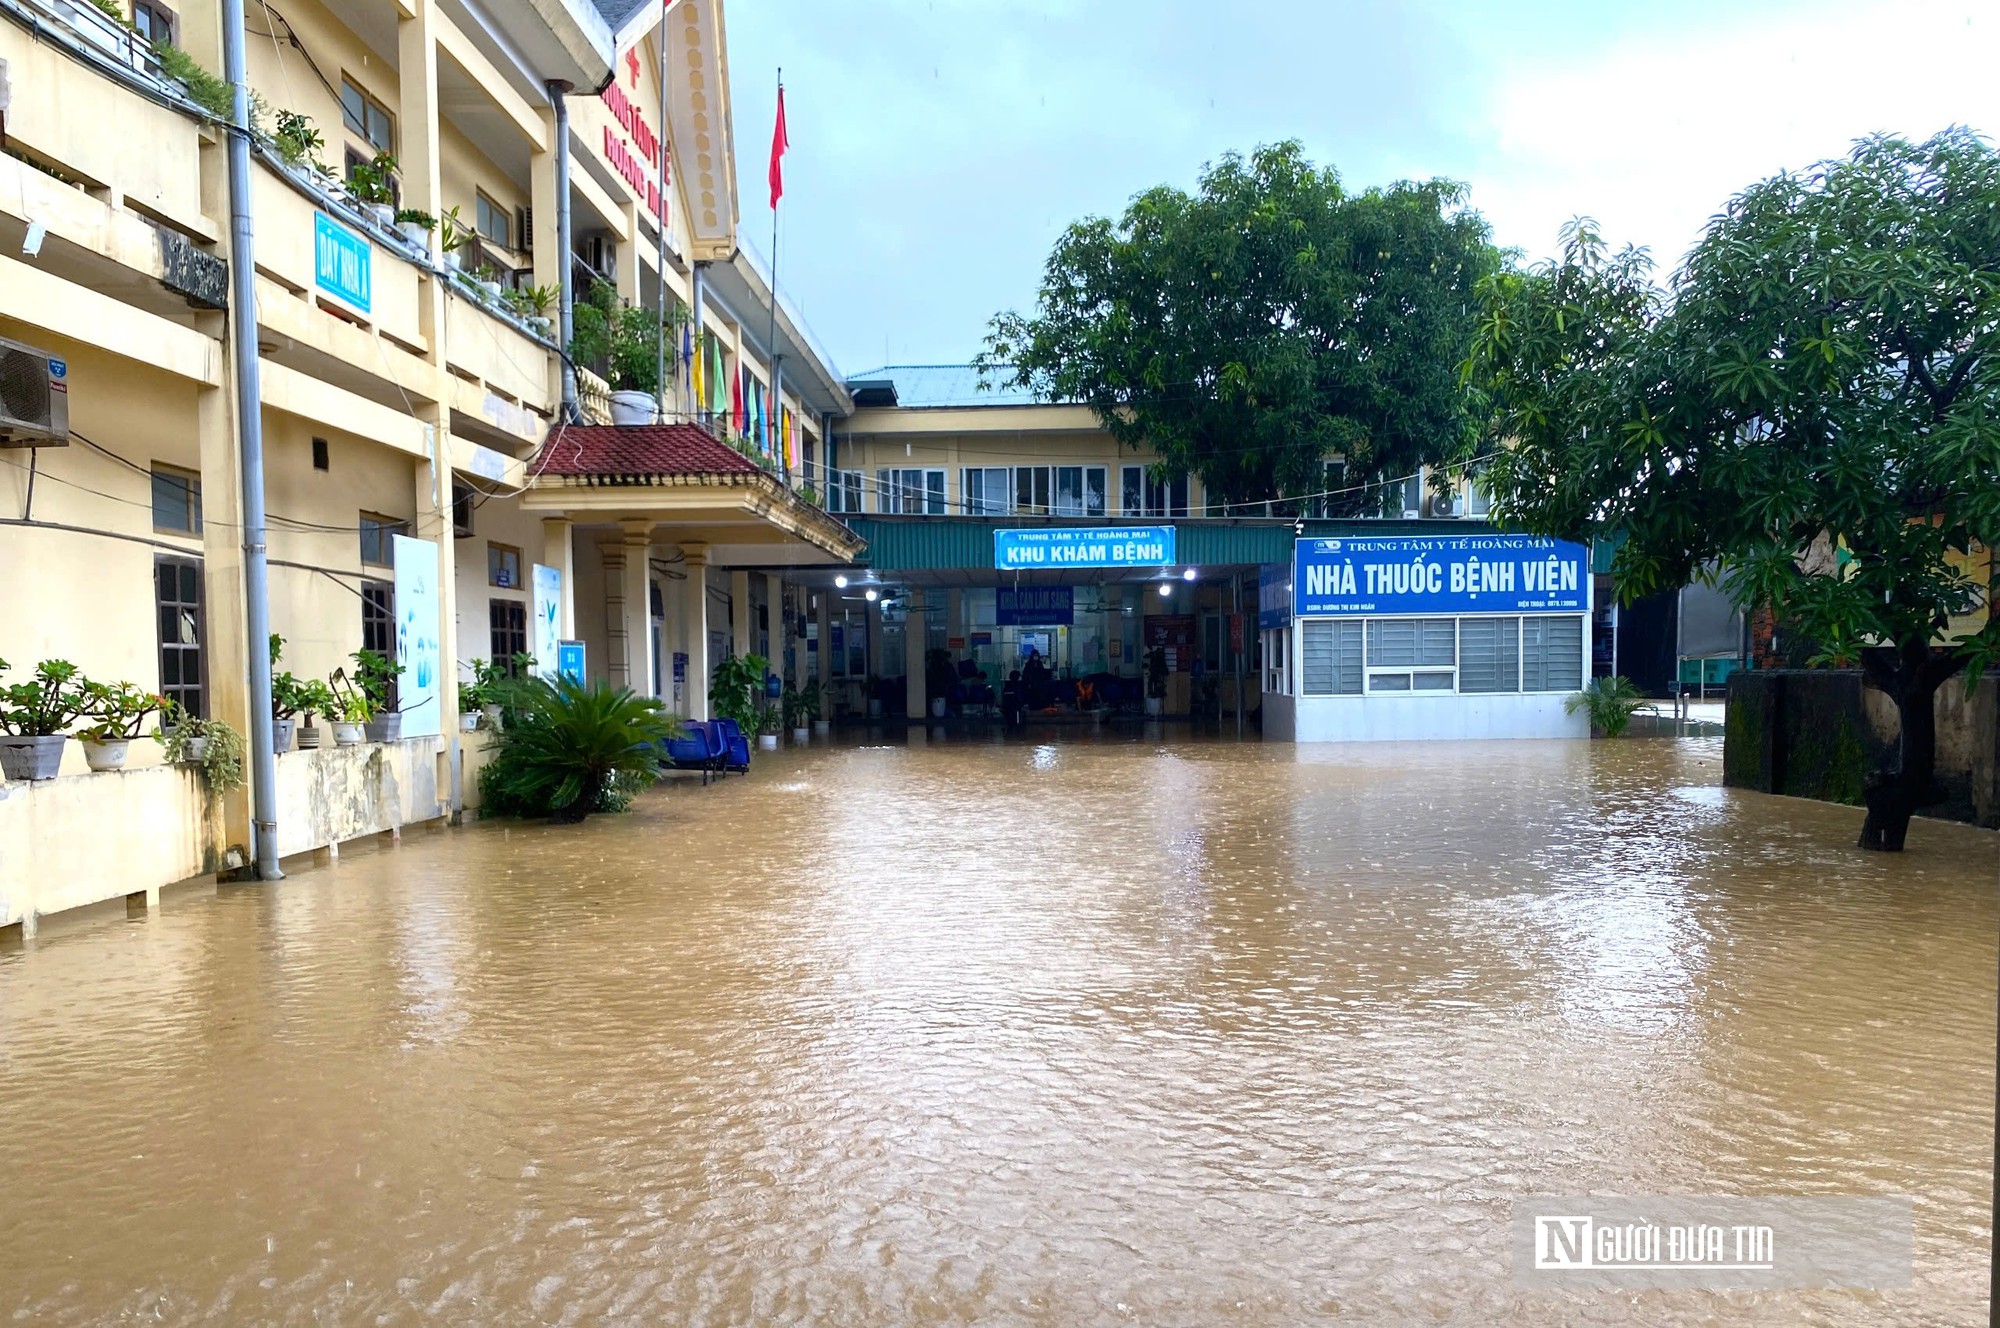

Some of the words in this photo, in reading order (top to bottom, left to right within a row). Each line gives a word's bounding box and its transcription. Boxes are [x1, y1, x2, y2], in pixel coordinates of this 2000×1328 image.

[341, 243, 360, 297] NHÀ
[361, 258, 368, 301] A
[1018, 533, 1049, 541] TRUNG
[1051, 532, 1072, 540] TÂM
[1074, 532, 1080, 540] Y
[1097, 530, 1129, 539] HOÀNG
[1131, 530, 1150, 539] MAI
[1347, 541, 1397, 552] TRUNG
[1401, 539, 1433, 551] TÂM
[1436, 541, 1446, 550] Y
[1449, 537, 1469, 550] TẾ
[1471, 538, 1523, 549] HOÀNG
[1007, 546, 1045, 563] KHU
[1050, 542, 1106, 562] KHÁM
[1112, 541, 1163, 565] BỆNH
[1306, 558, 1357, 595] NHÀ
[1363, 552, 1442, 594] THUỐC
[1450, 555, 1515, 599] BỆNH
[1522, 554, 1578, 597] VIỆN
